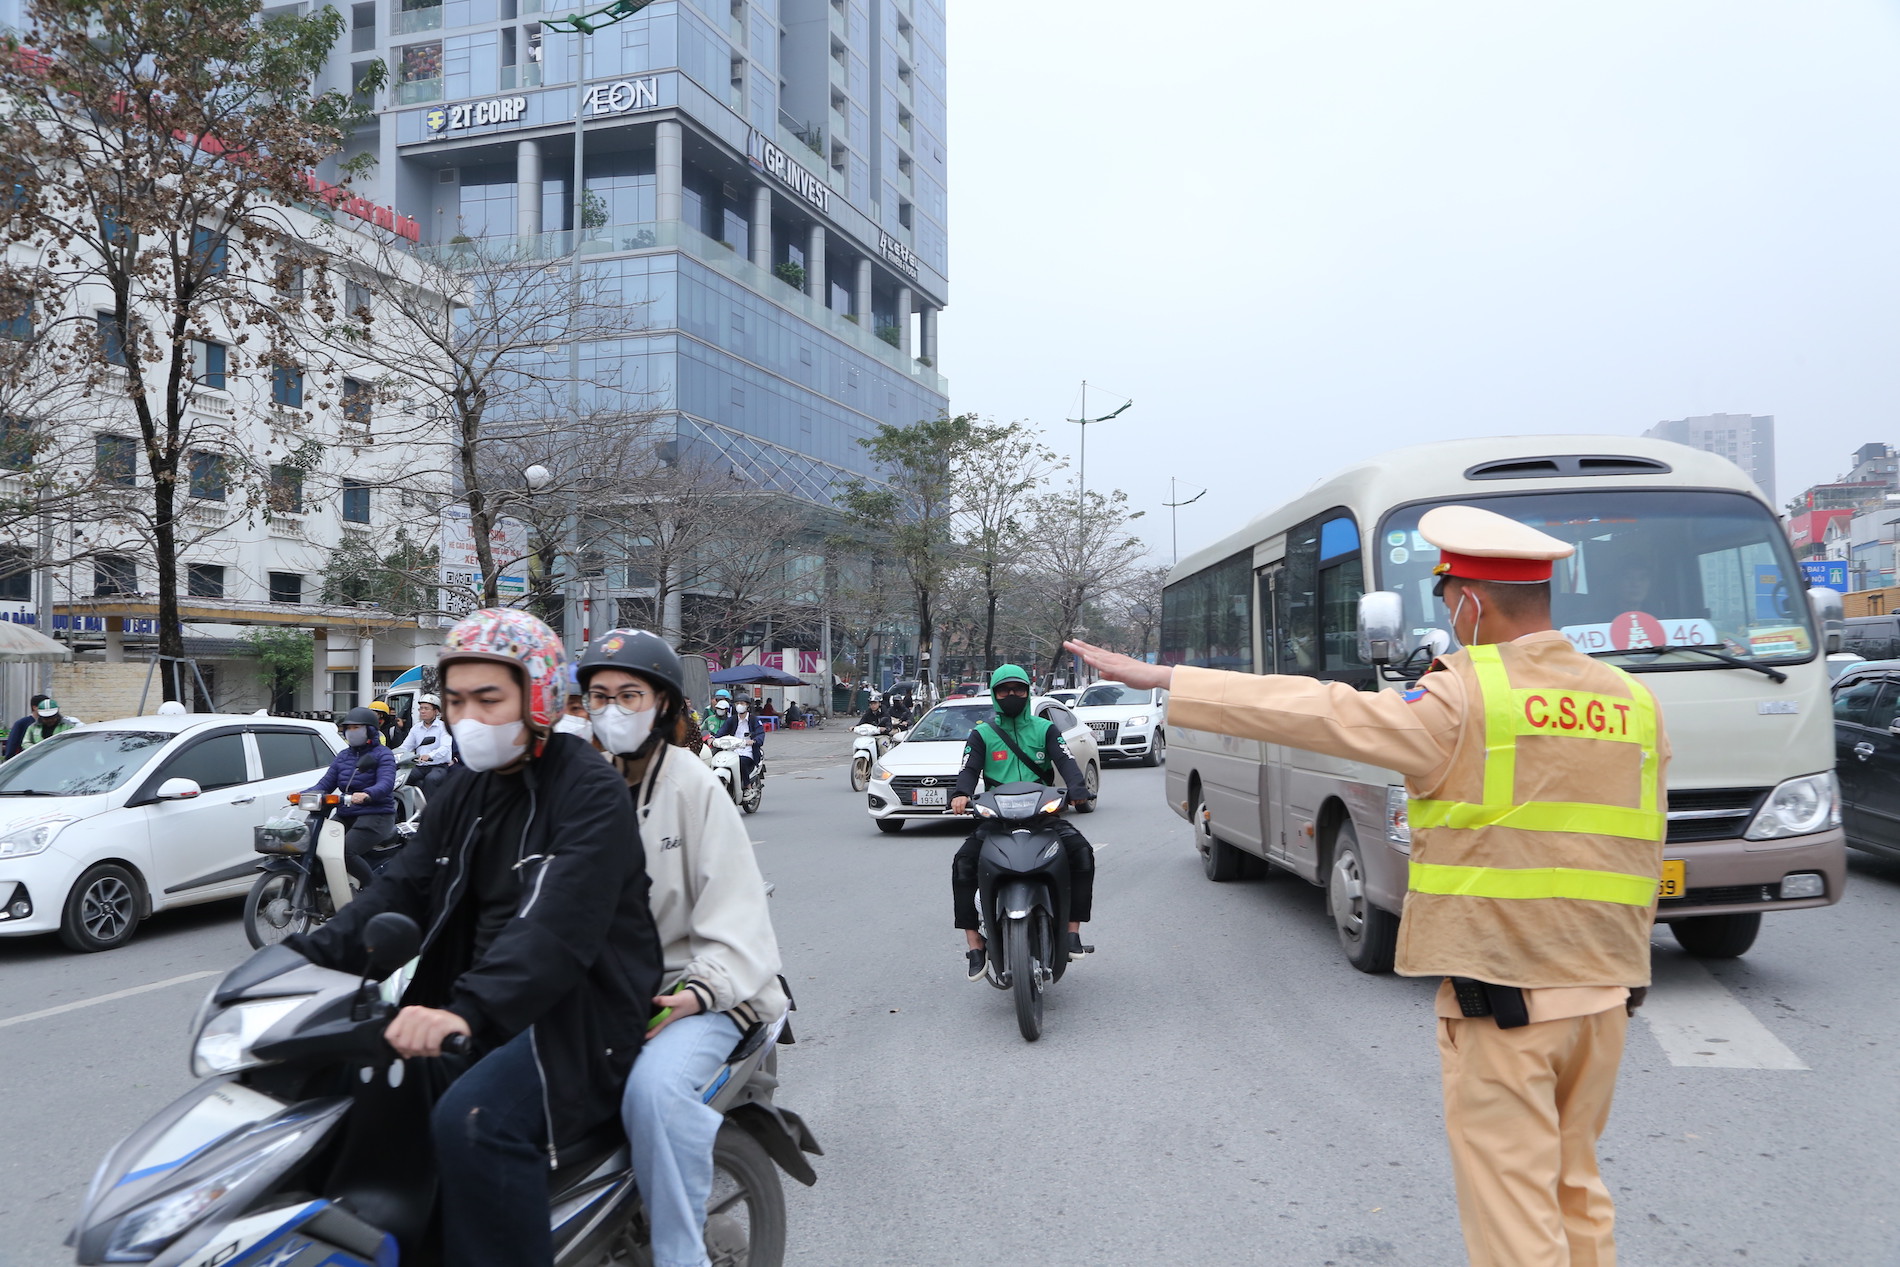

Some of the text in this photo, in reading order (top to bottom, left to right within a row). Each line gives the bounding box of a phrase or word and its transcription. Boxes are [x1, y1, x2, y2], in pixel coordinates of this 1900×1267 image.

[451, 97, 526, 129] 2T CORP
[1673, 624, 1704, 646] 46
[1525, 695, 1630, 735] C.S.G.T
[925, 789, 938, 797] 22A
